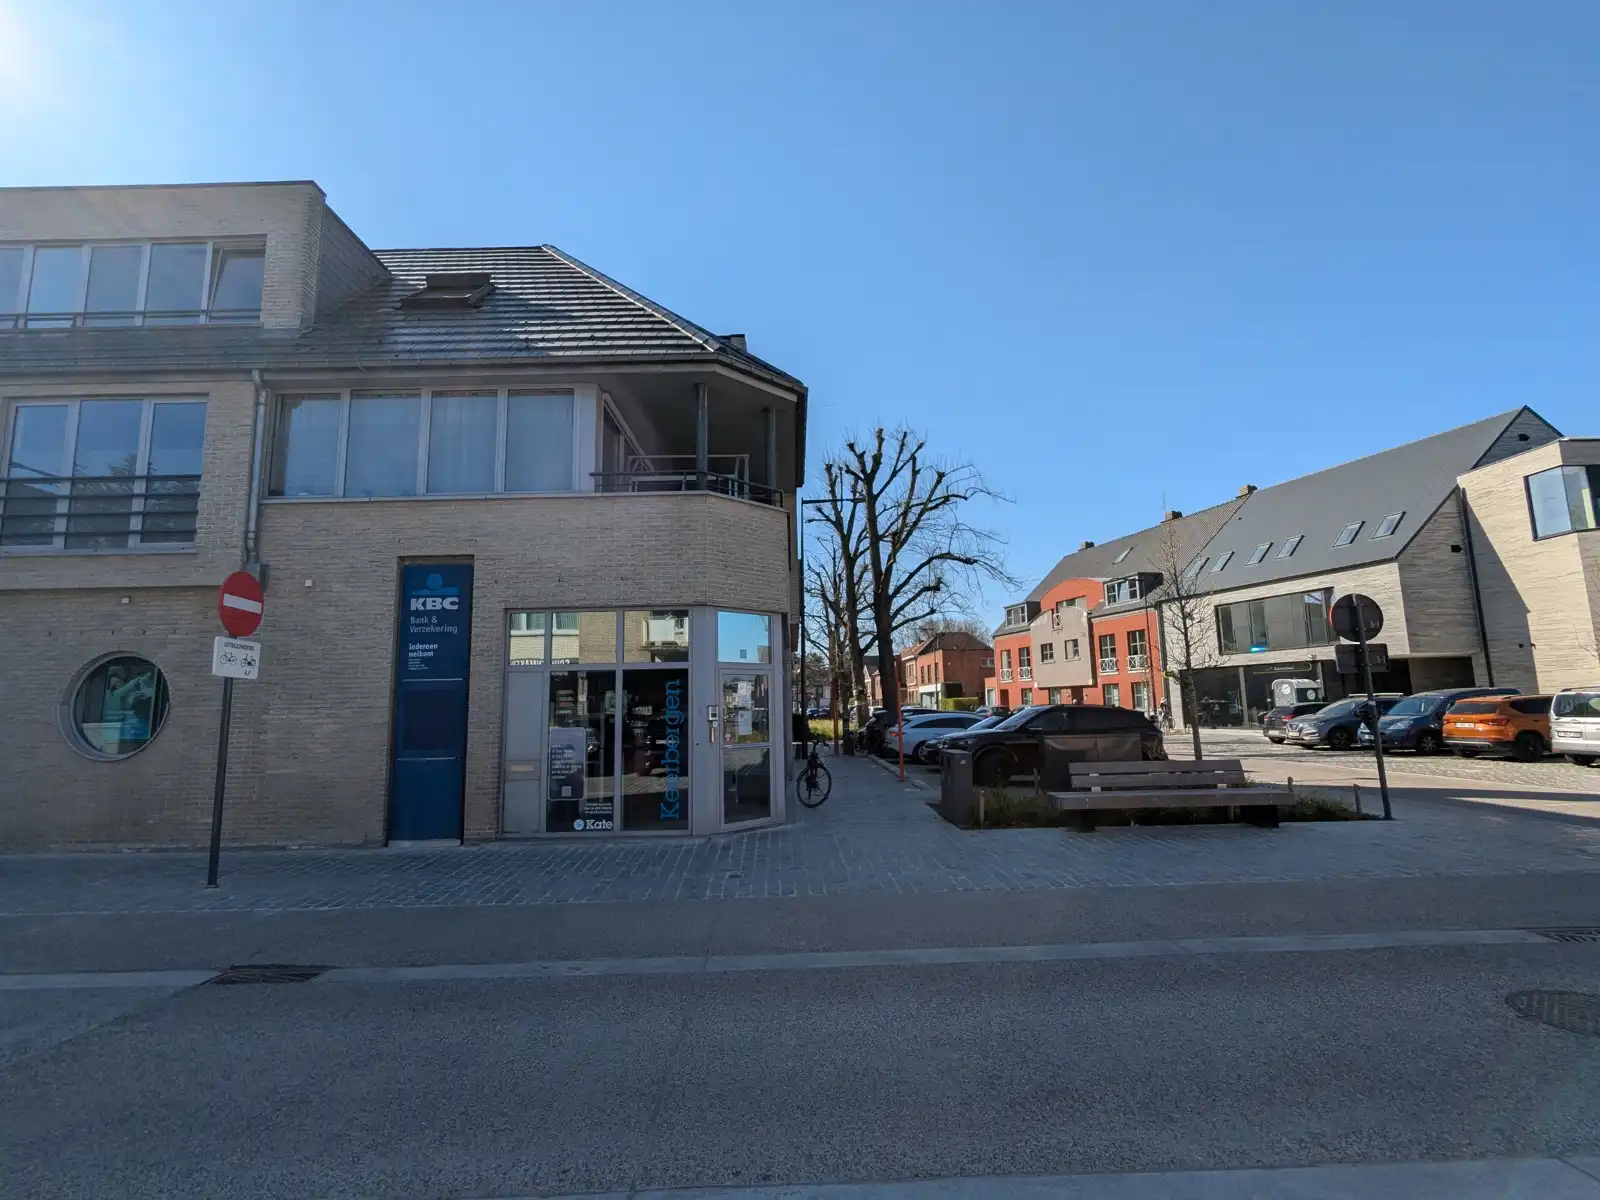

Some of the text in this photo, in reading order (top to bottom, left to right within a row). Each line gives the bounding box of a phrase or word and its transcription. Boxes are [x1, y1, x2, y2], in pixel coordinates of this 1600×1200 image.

[410, 597, 459, 610] KBC
[410, 615, 438, 624] Bank &
[410, 624, 458, 634] Verzekering
[408, 643, 438, 651] Iedereen
[660, 679, 684, 820] Keerbergen
[585, 819, 613, 830] Kate
